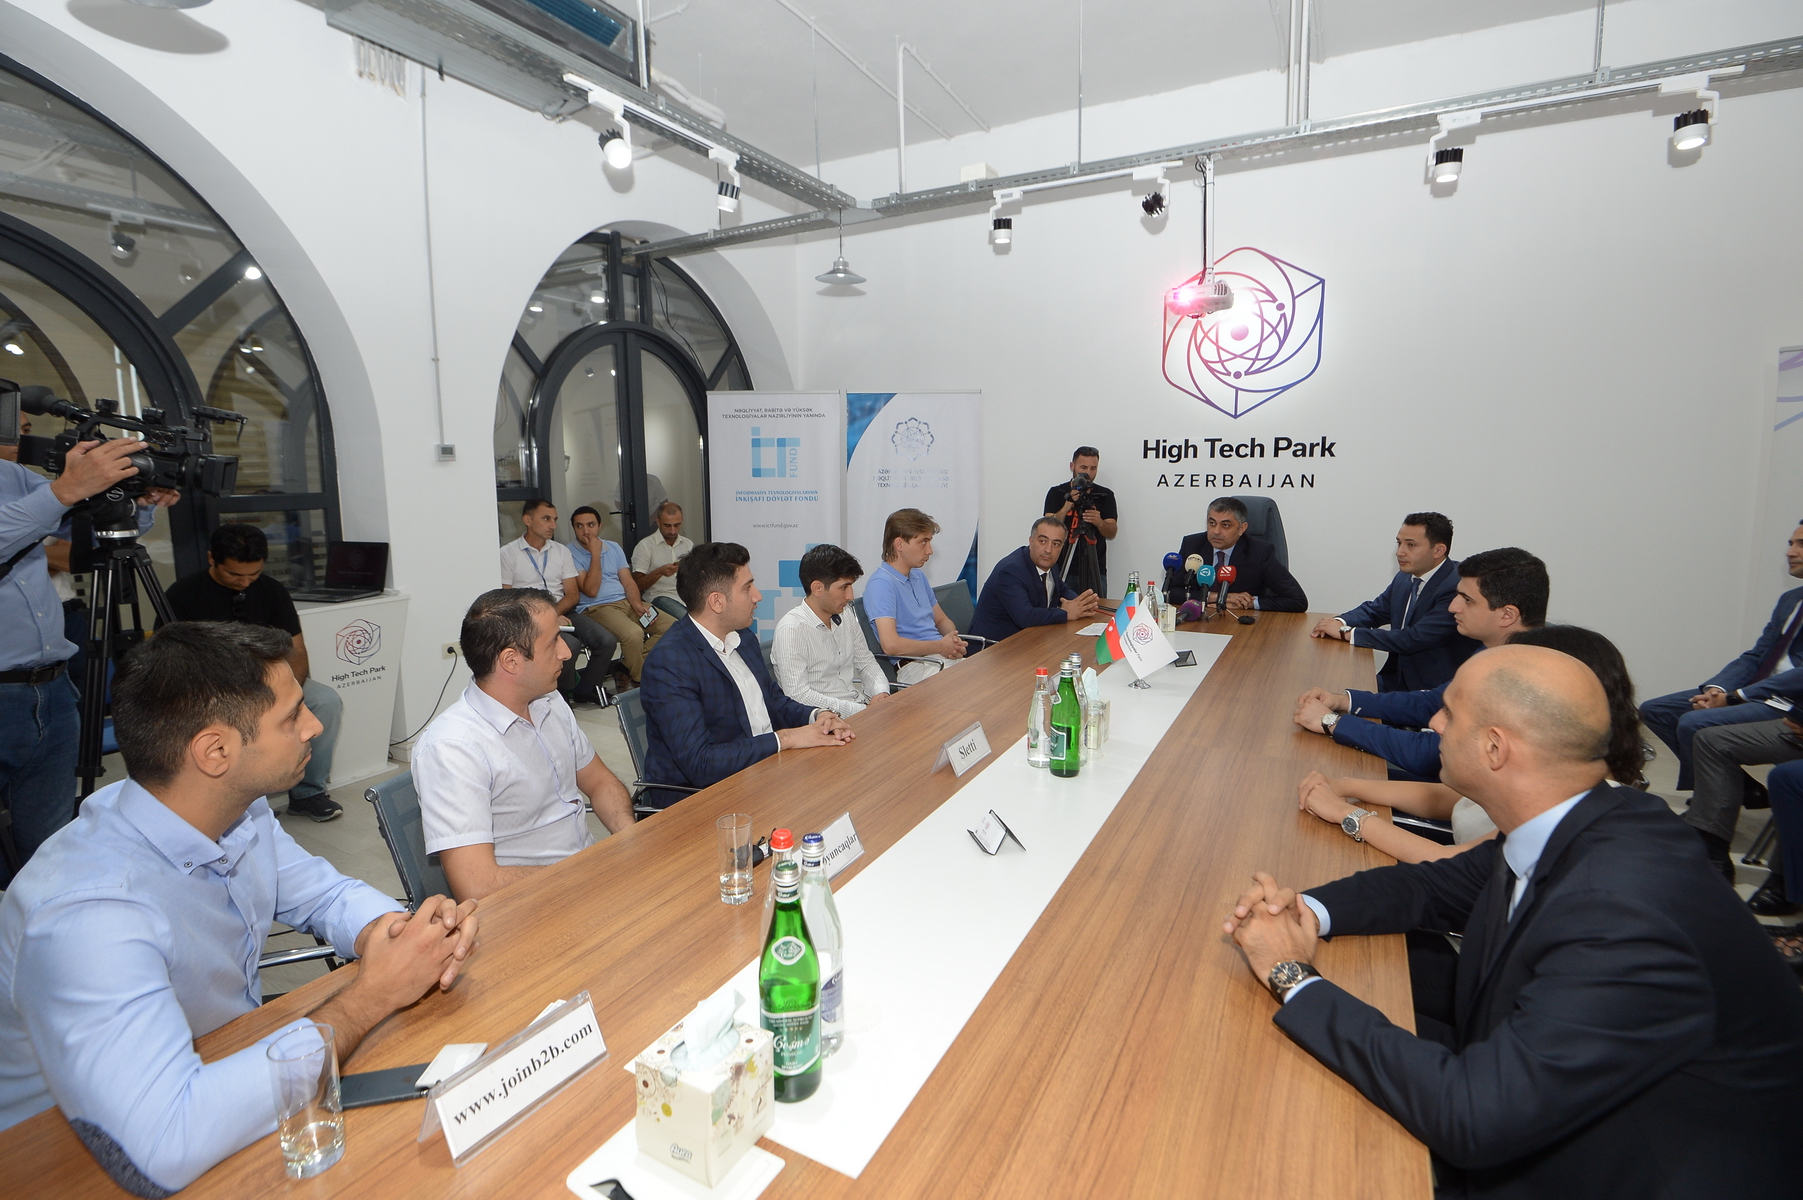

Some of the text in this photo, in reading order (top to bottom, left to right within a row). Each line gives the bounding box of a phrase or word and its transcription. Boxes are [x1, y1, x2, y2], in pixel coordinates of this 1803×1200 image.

[1142, 436, 1337, 464] High Tech Park
[789, 447, 798, 478] FUND
[1156, 474, 1315, 488] AZERBAIJAN
[331, 665, 386, 682] High Tech Park
[336, 676, 382, 689] AZERBAIJAN
[453, 1023, 593, 1125] www.joinb2b.com
